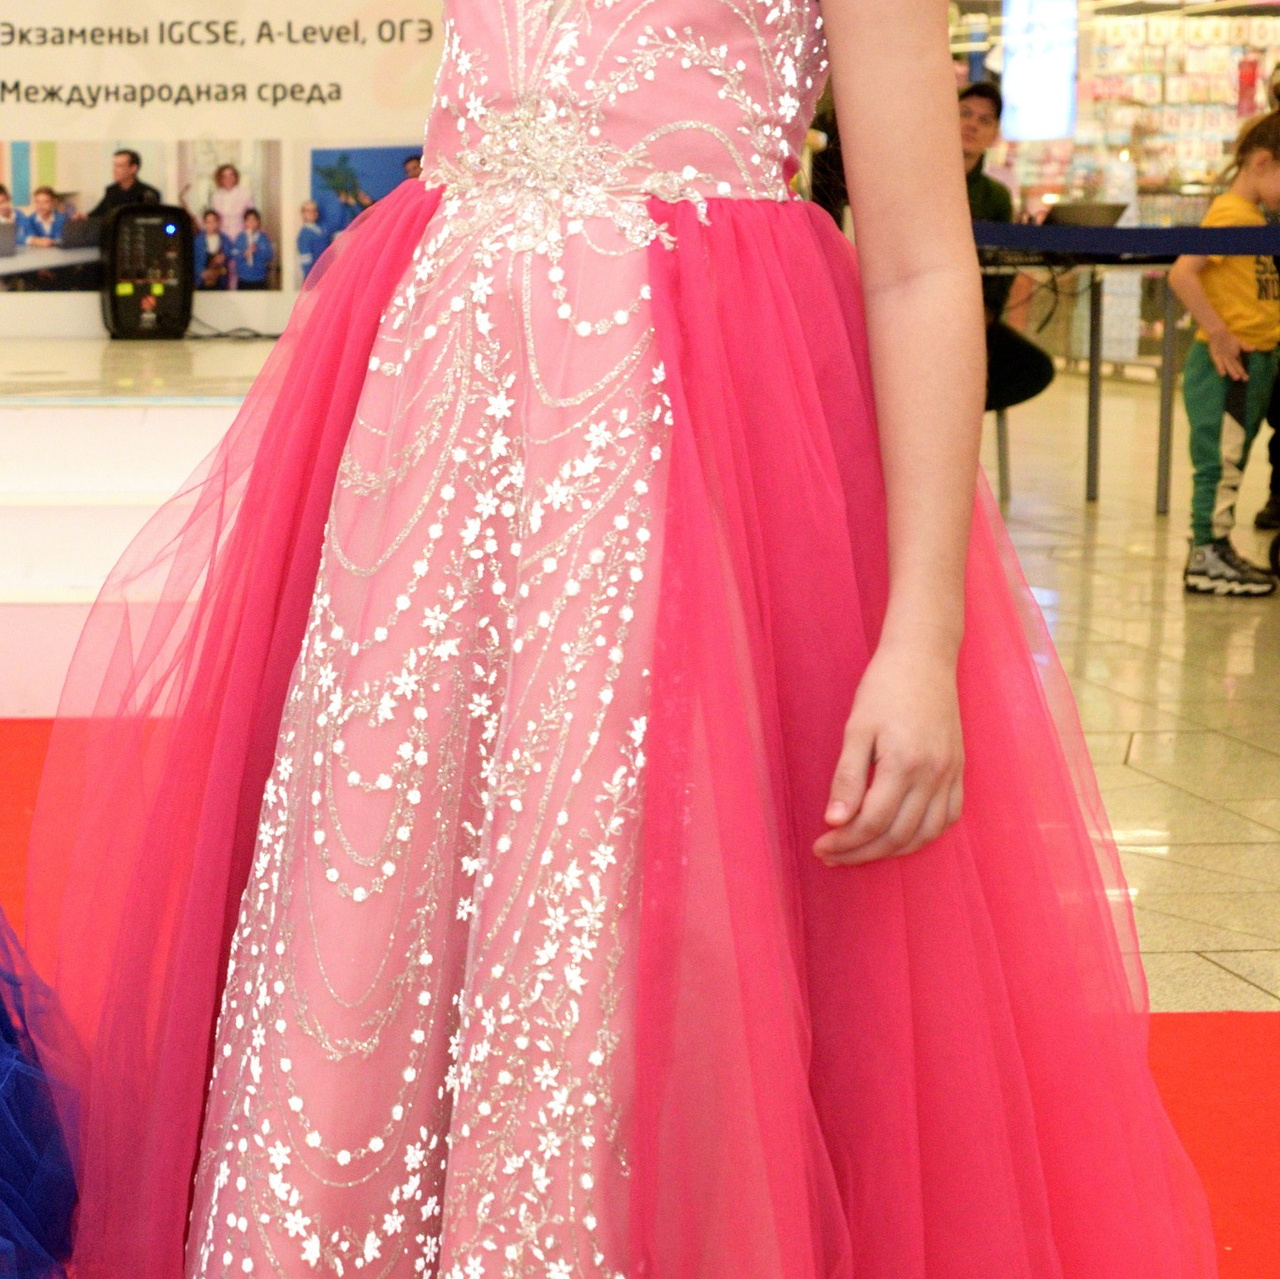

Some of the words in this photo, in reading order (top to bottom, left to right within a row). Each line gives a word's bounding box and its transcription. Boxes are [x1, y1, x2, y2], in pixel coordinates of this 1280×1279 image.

[0, 21, 149, 47] Экзамены
[158, 20, 245, 47] IGCSE,
[256, 19, 367, 46] A-Level,
[377, 18, 433, 43] ОГЭ
[0, 79, 247, 110] Международная
[257, 82, 342, 107] среда
